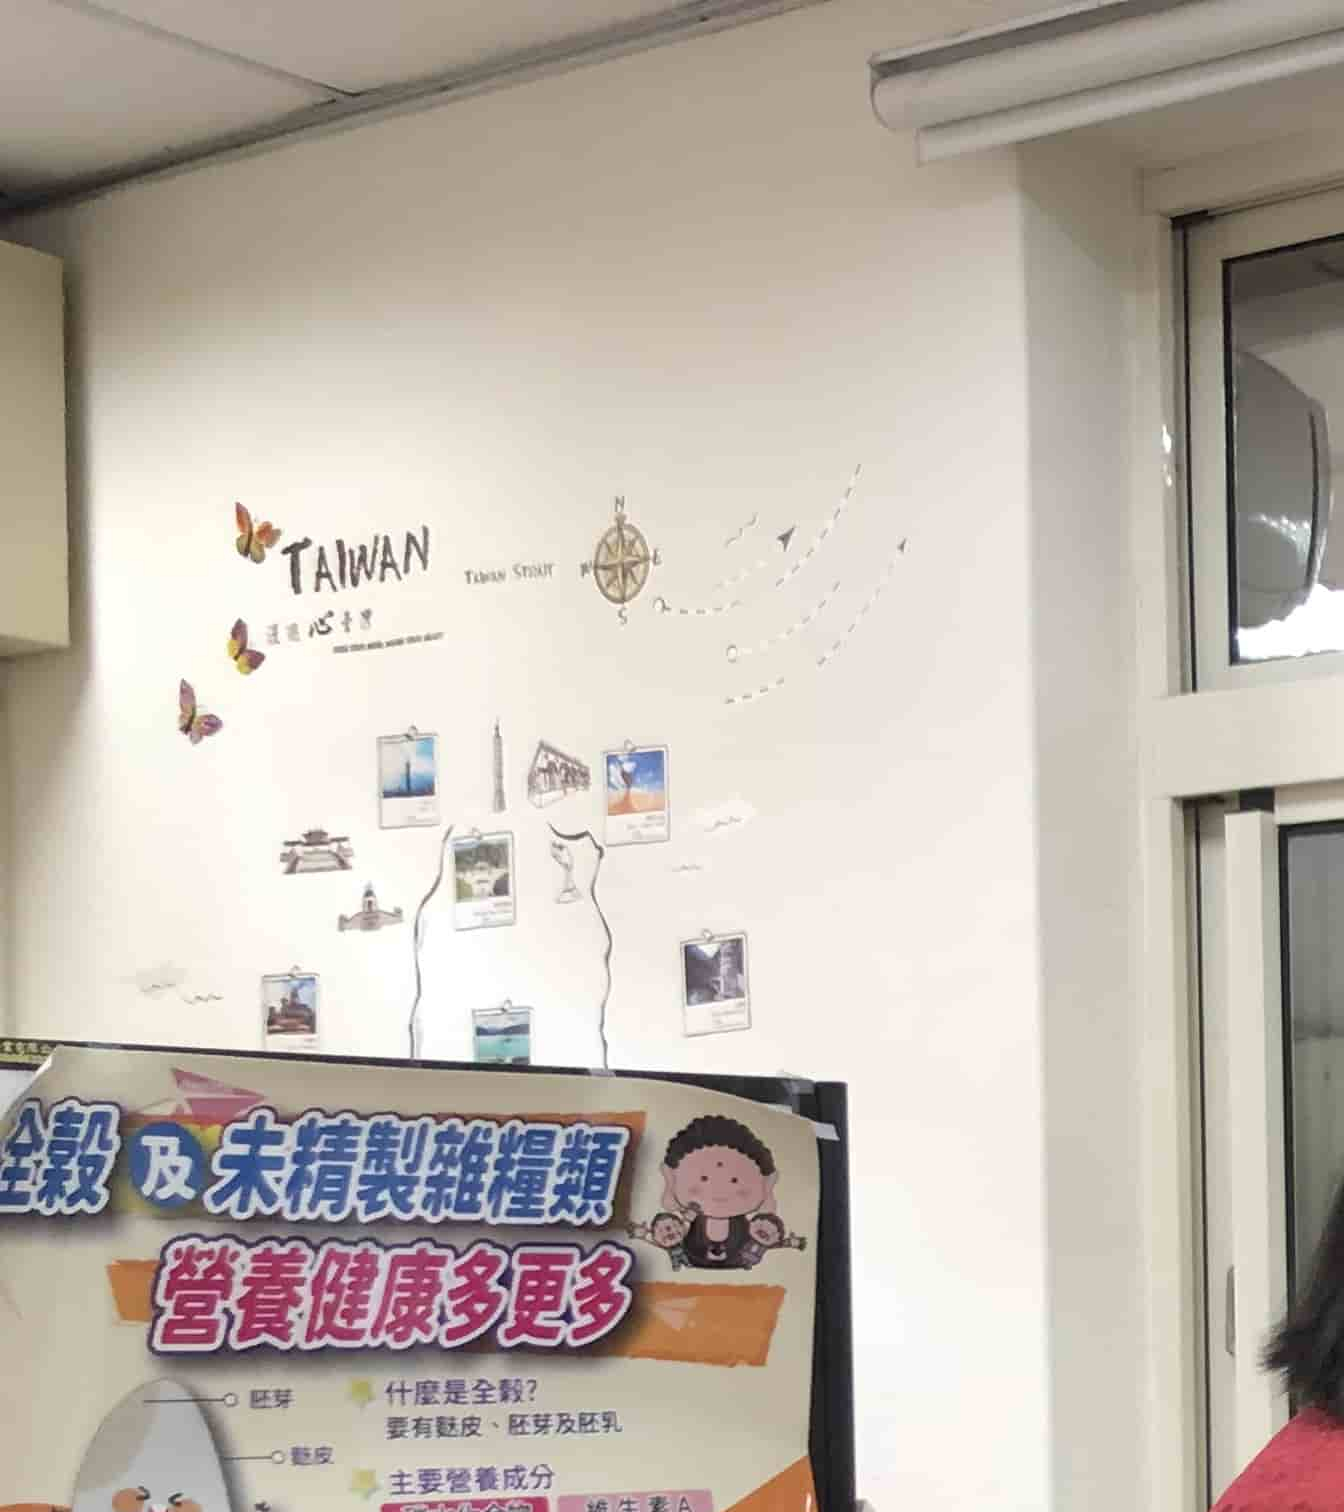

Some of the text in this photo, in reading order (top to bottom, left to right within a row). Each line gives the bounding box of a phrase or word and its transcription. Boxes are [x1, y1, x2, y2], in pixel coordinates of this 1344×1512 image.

[282, 525, 429, 595] TAIWAN
[0, 1101, 628, 1222] 全穀 及 未精製雜糧類
[156, 1240, 632, 1350] 營養健康多更多
[249, 1389, 295, 1410] 胚芽
[385, 1378, 538, 1406] 什麼是全穀?
[390, 1464, 556, 1496] 主要營養成分
